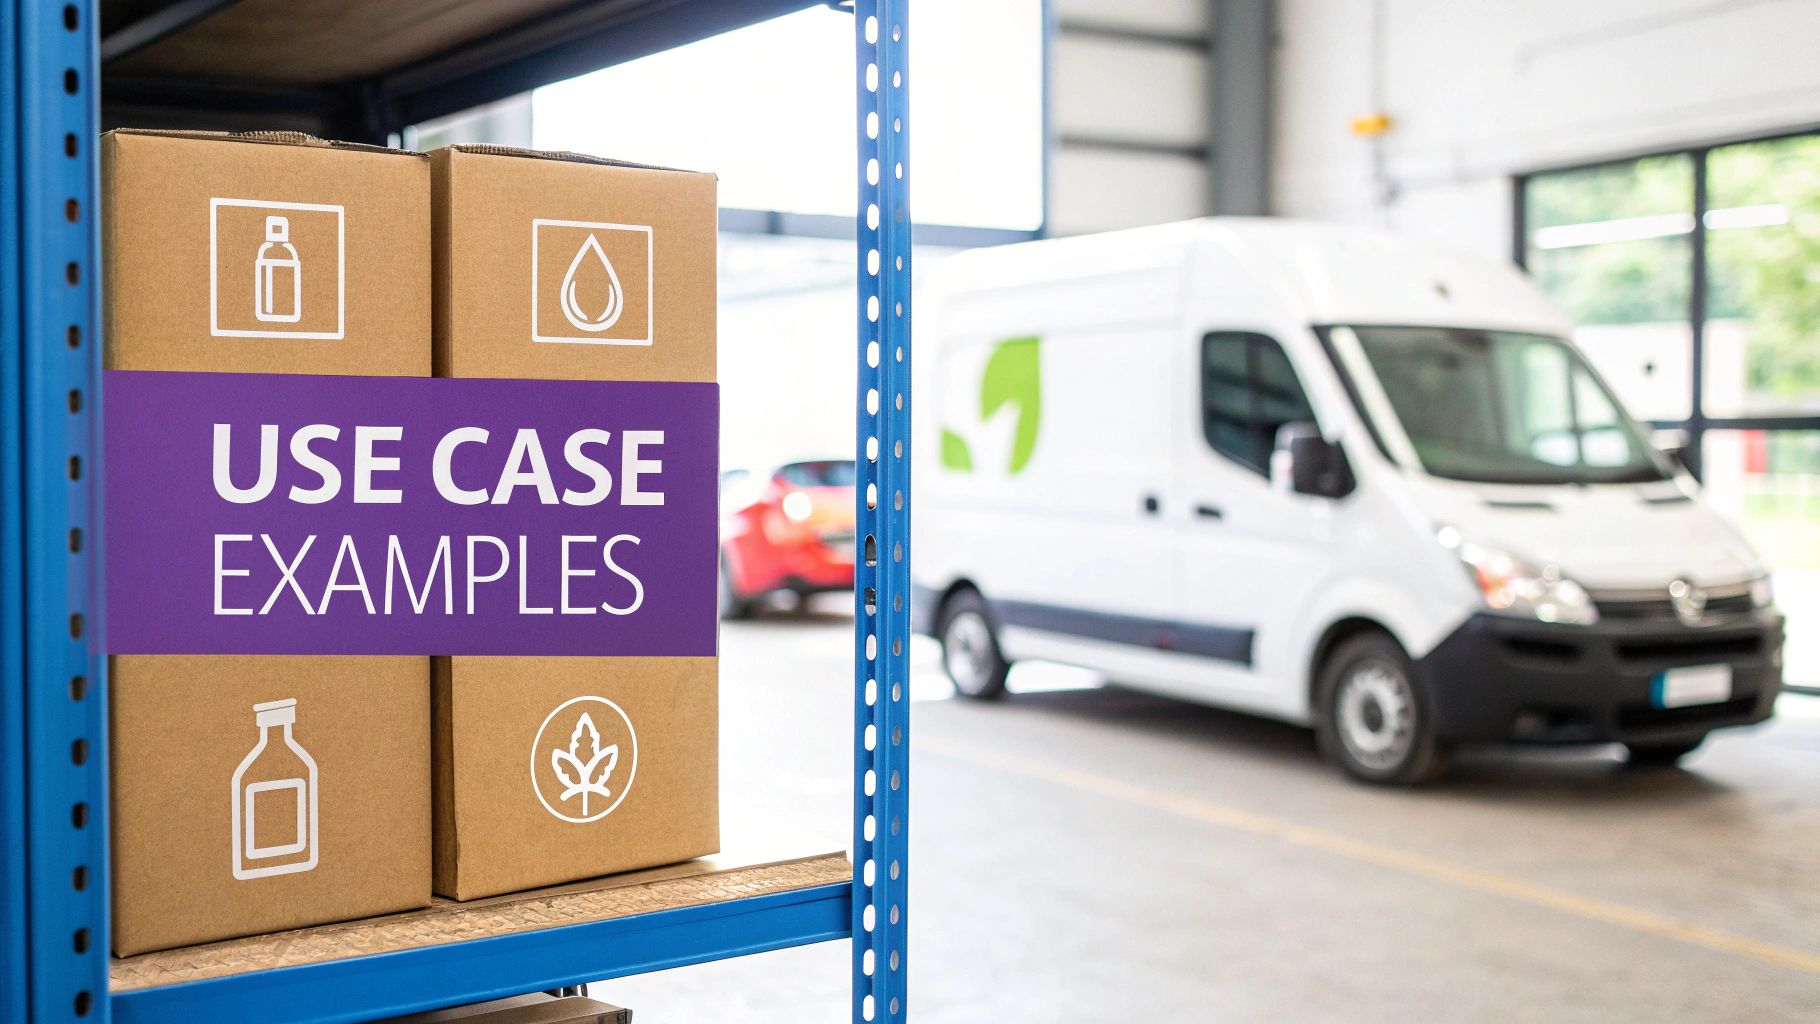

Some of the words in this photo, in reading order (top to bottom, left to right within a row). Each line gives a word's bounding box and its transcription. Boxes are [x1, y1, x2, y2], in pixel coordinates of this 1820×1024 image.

[212, 423, 404, 505] USE
[432, 426, 665, 506] CASE
[213, 533, 644, 616] EXAMPLES
